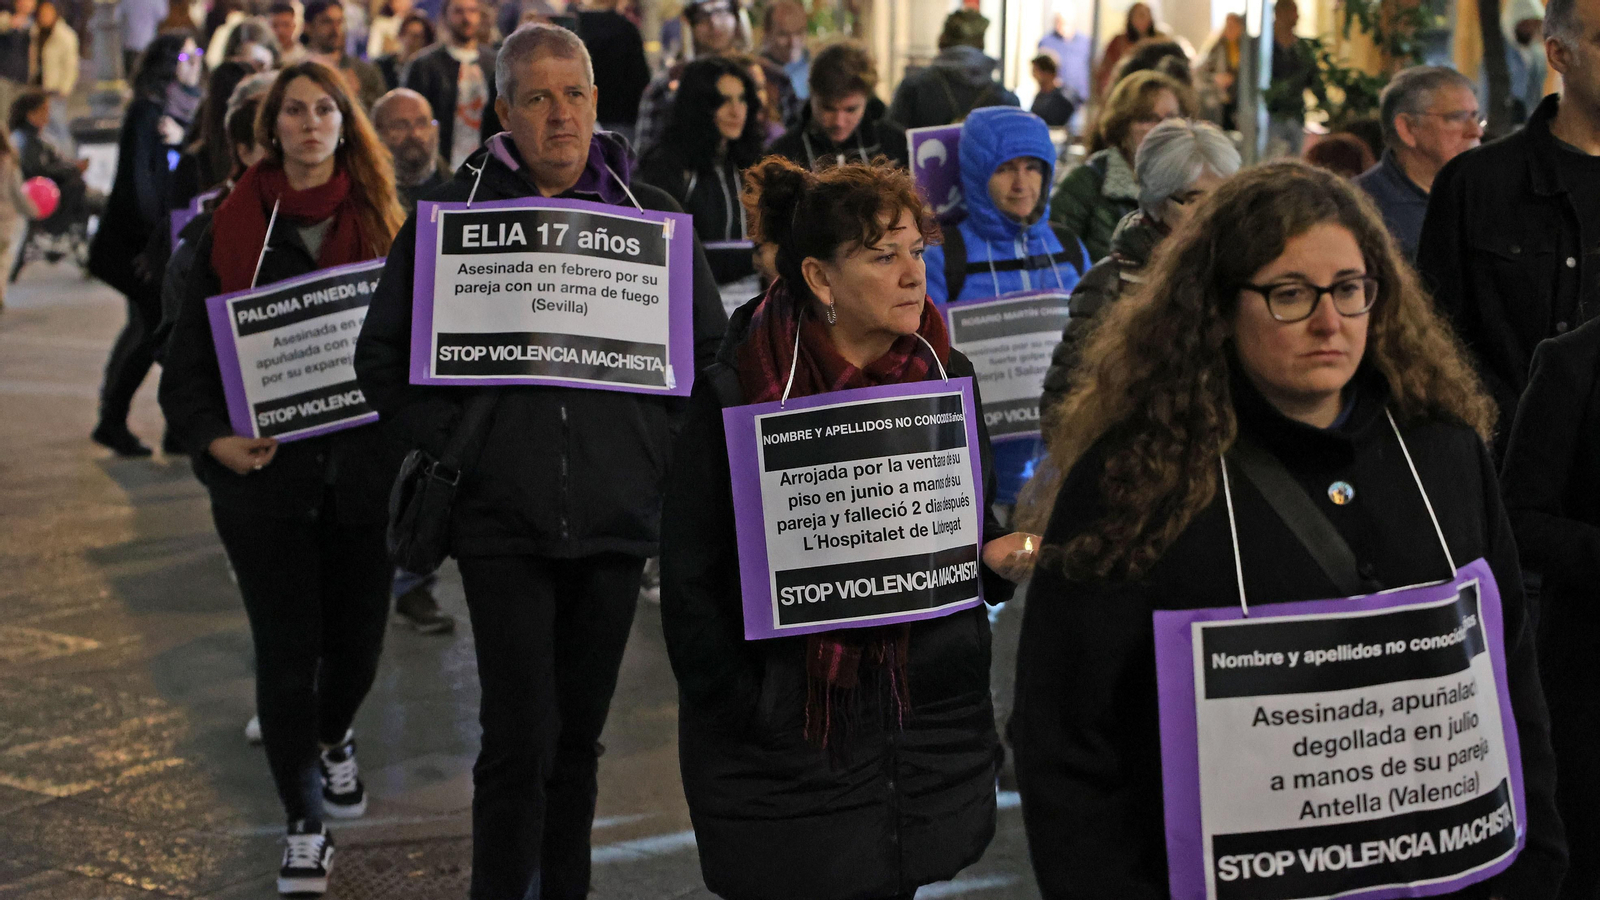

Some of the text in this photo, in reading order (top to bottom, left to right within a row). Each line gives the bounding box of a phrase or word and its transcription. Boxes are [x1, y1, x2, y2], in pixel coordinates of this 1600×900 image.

[462, 223, 641, 256] ELIA 17 años
[457, 261, 658, 286] Asesinada en febrero por su
[237, 298, 302, 324] PALOMA
[302, 283, 357, 308] PINEDO
[454, 280, 659, 306] pareja con un arma de fuego
[531, 298, 588, 316] (Sevilla)
[273, 323, 337, 349] Asesinada
[340, 319, 356, 331] en
[256, 343, 321, 369] apuñalada
[324, 337, 349, 352] con
[439, 345, 664, 372] STOP VIOLENCIA MACHISTA
[261, 373, 283, 387] por
[286, 369, 302, 379] su
[257, 389, 366, 427] STOP VIOLENCI
[763, 428, 813, 446] NOMBRE
[815, 428, 823, 439] Y
[825, 418, 893, 437] APELLIDOS
[896, 416, 912, 428] NO
[779, 465, 848, 487] Arrojada
[853, 460, 883, 480] por
[888, 458, 903, 473] la
[906, 454, 946, 470] ventana
[952, 453, 961, 465] su
[788, 493, 821, 511] piso
[825, 489, 846, 504] en
[850, 482, 894, 504] junio
[899, 483, 909, 495] a
[913, 478, 945, 494] manos
[951, 475, 961, 487] su
[776, 514, 826, 535] pareja
[830, 513, 840, 528] y
[844, 500, 908, 524] falleció
[912, 500, 922, 515] 2
[909, 521, 929, 538] de
[780, 560, 978, 606] STOP VIOLENCIA MACHISTA
[1212, 650, 1284, 670] Nombre
[1288, 651, 1299, 667] y
[1303, 642, 1382, 666] apellidos
[1385, 640, 1406, 655] no
[1252, 697, 1385, 727] Asesinada,
[1293, 710, 1479, 758] degollada en julio
[1270, 775, 1284, 791] a
[1294, 768, 1373, 790] manos
[1381, 757, 1406, 778] de
[1414, 755, 1441, 772] su
[1300, 770, 1480, 820] Antella (Valencia)
[1217, 851, 1295, 881] STOP
[1298, 834, 1437, 874] VIOLENCIA
